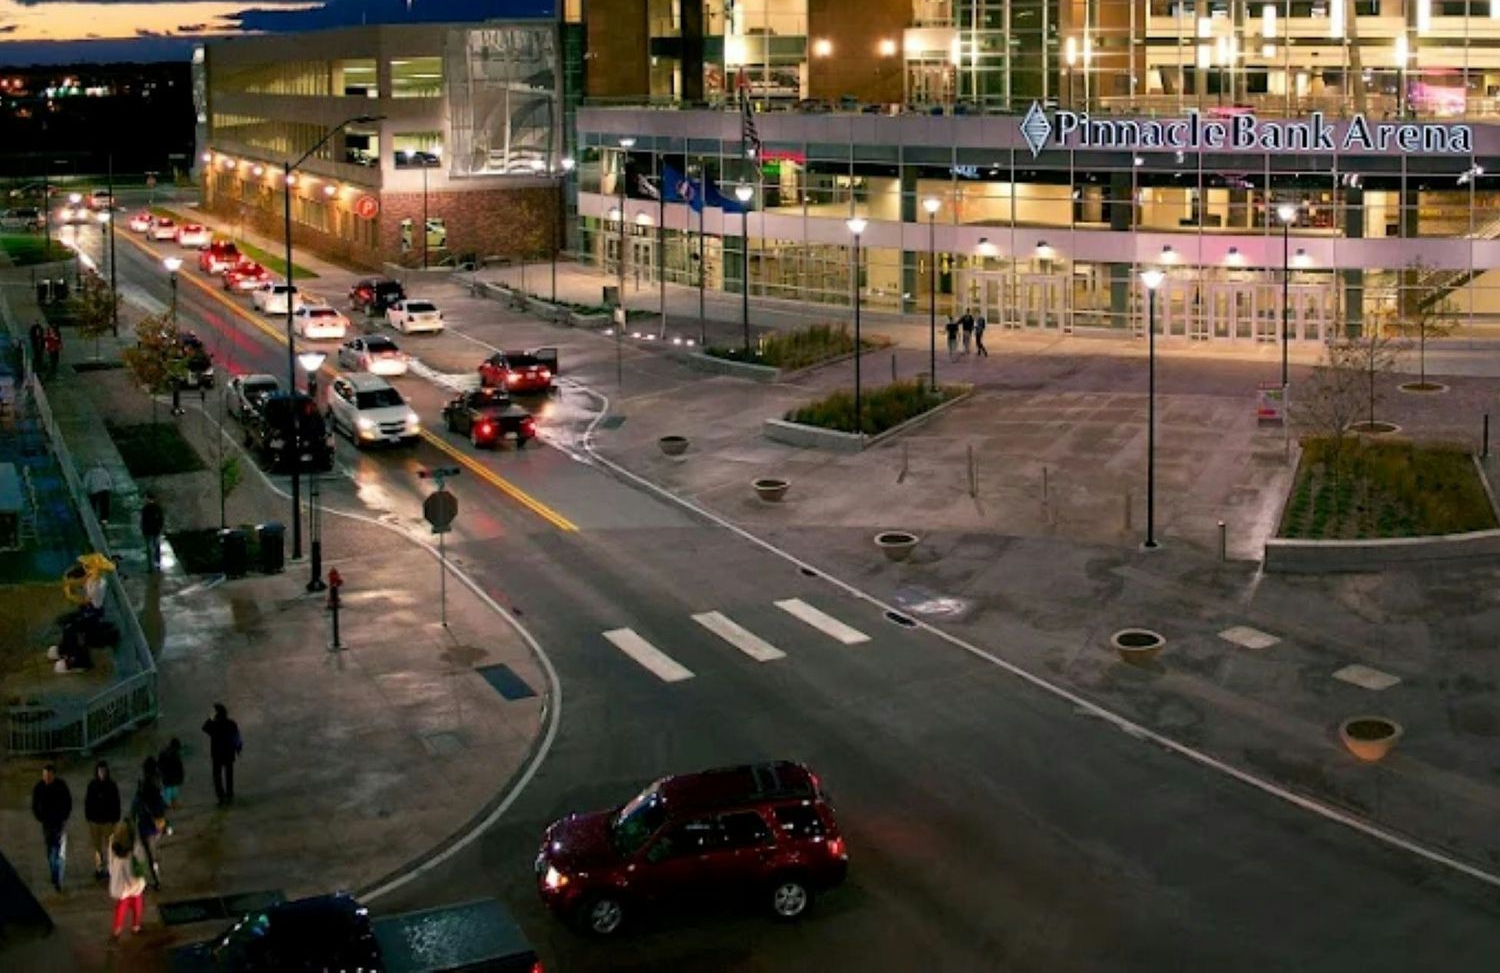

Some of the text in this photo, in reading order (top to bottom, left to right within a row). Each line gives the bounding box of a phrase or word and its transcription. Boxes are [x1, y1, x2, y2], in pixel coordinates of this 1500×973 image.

[1054, 110, 1473, 152] Pinnacle Bank Arena
